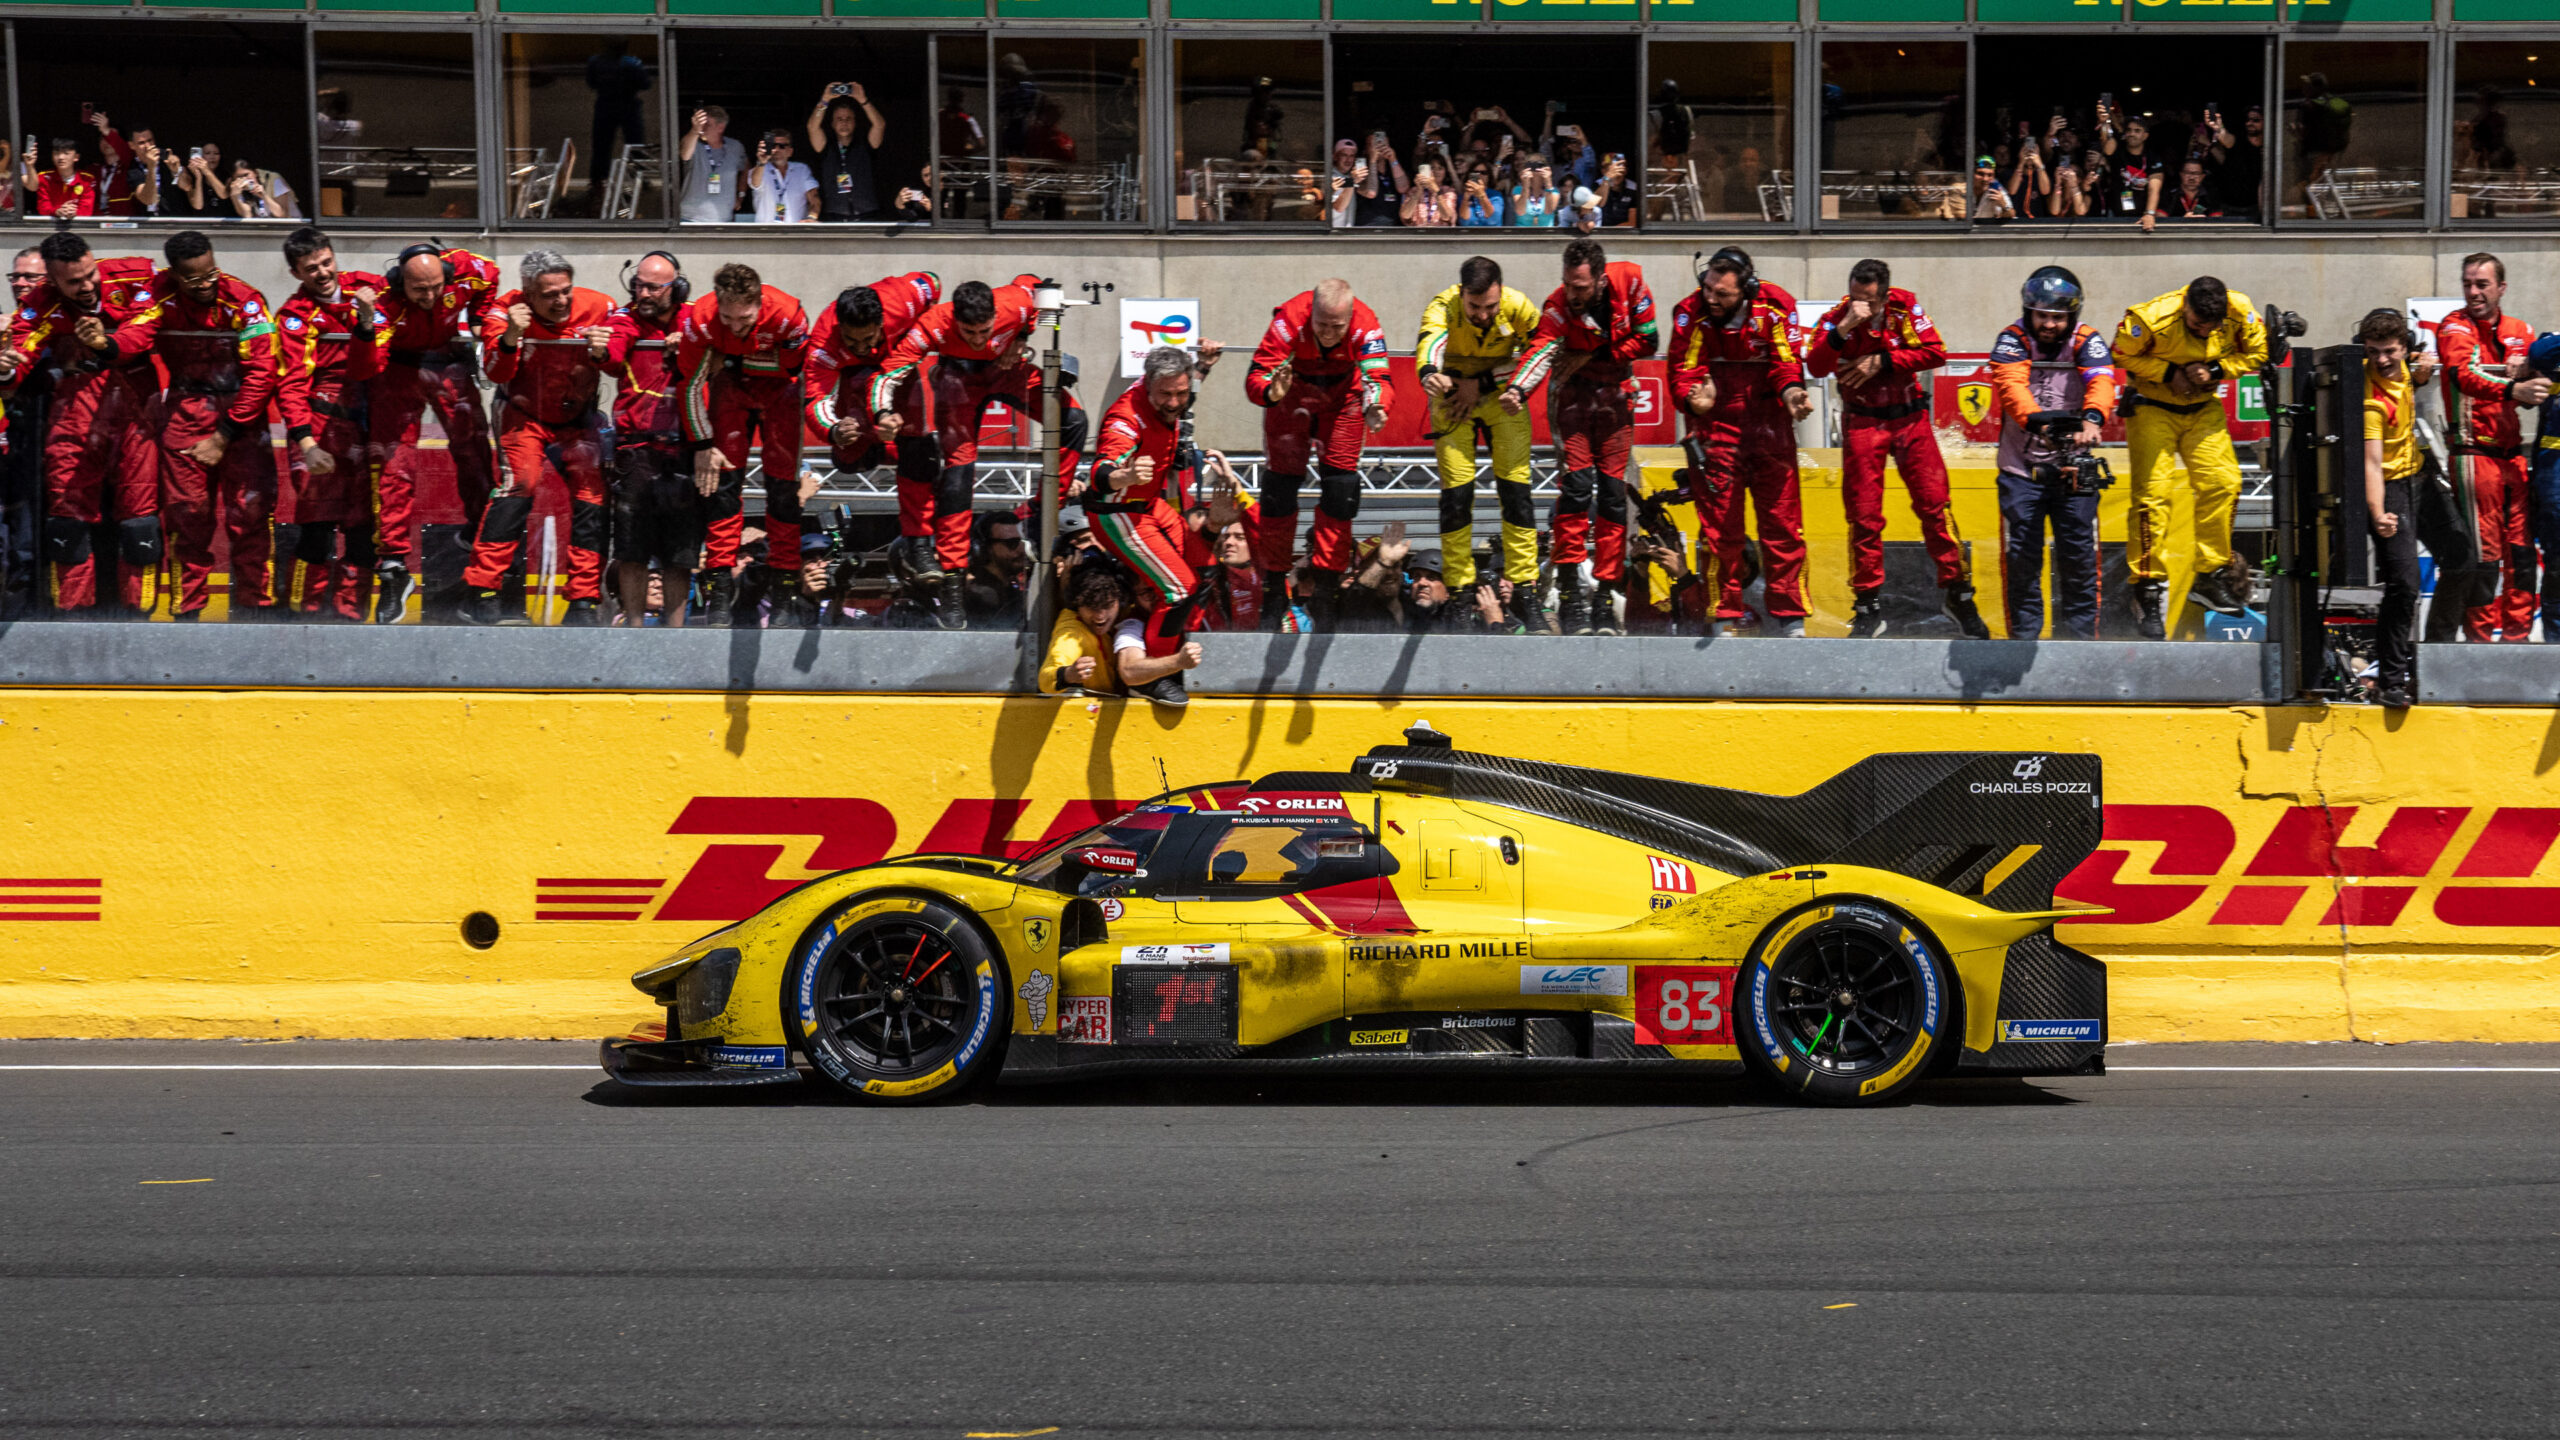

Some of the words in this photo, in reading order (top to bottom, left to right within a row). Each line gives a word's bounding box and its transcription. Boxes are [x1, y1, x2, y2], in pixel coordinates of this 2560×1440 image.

[2222, 627, 2253, 641] TV
[1970, 782, 2043, 794] CHARLES
[2046, 782, 2091, 794] POZZI
[1276, 798, 1343, 810] ORLEN
[1102, 855, 1135, 867] ORLEN
[1650, 856, 1687, 891] HY
[1104, 905, 1116, 918] E
[1350, 943, 1450, 961] RICHARD
[1460, 941, 1528, 958] MILLE
[801, 930, 833, 1006] MICHELIN
[1916, 953, 1938, 1030] MICHELIN
[1659, 979, 1721, 1031] 83
[1753, 969, 1775, 1045] MICHELIN
[958, 990, 992, 1065] MICHELIN
[1057, 1015, 1107, 1040] CAR
[1442, 1015, 1517, 1029] Britestone
[1354, 1030, 1402, 1044] Sabelt
[2025, 1026, 2091, 1036] MICHELIN
[712, 1052, 776, 1063] MICHELIN
